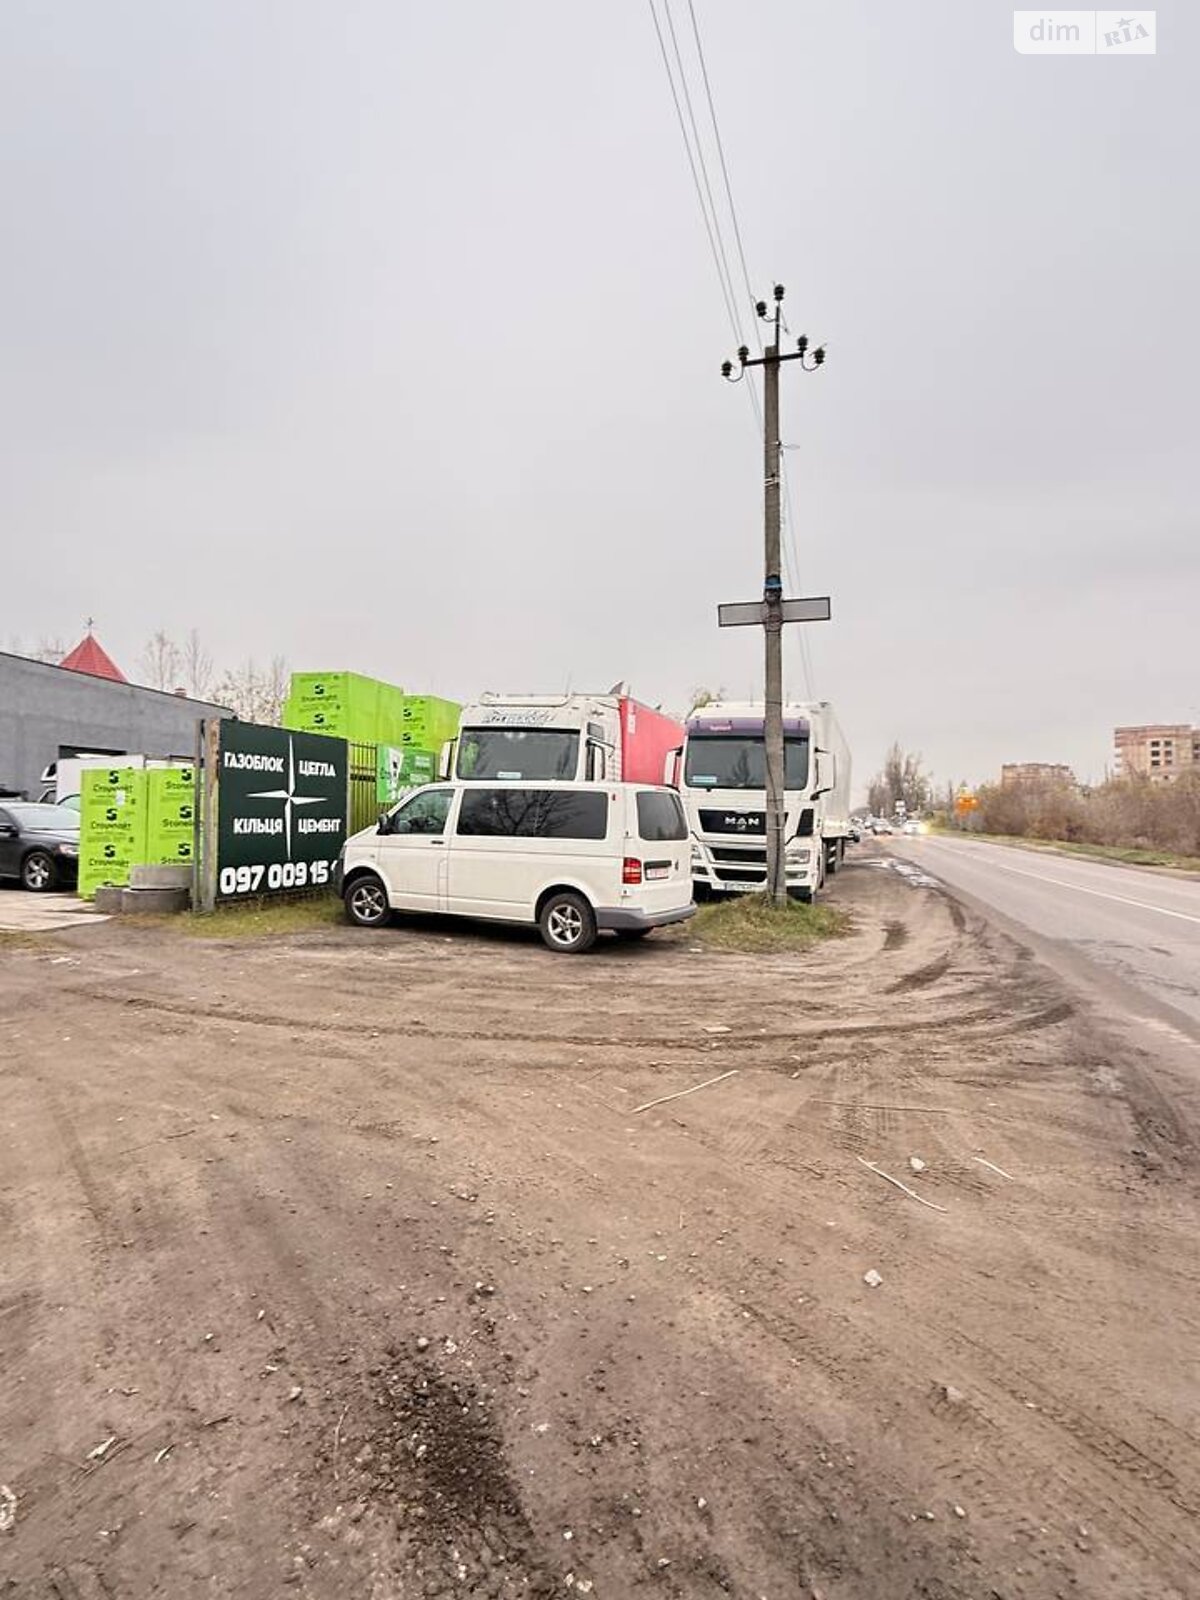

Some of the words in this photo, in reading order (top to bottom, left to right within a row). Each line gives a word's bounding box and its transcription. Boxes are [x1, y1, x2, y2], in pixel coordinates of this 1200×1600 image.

[224, 752, 284, 772] ГАЗОБЛОК
[299, 760, 336, 777] ЦЕГЛА
[233, 818, 283, 835] КІЛЬЦЯ
[298, 818, 341, 835] ЦЕМЕНТ
[724, 816, 760, 827] MAN
[220, 865, 265, 894] 097
[268, 861, 307, 889] 009
[309, 860, 329, 884] 15
